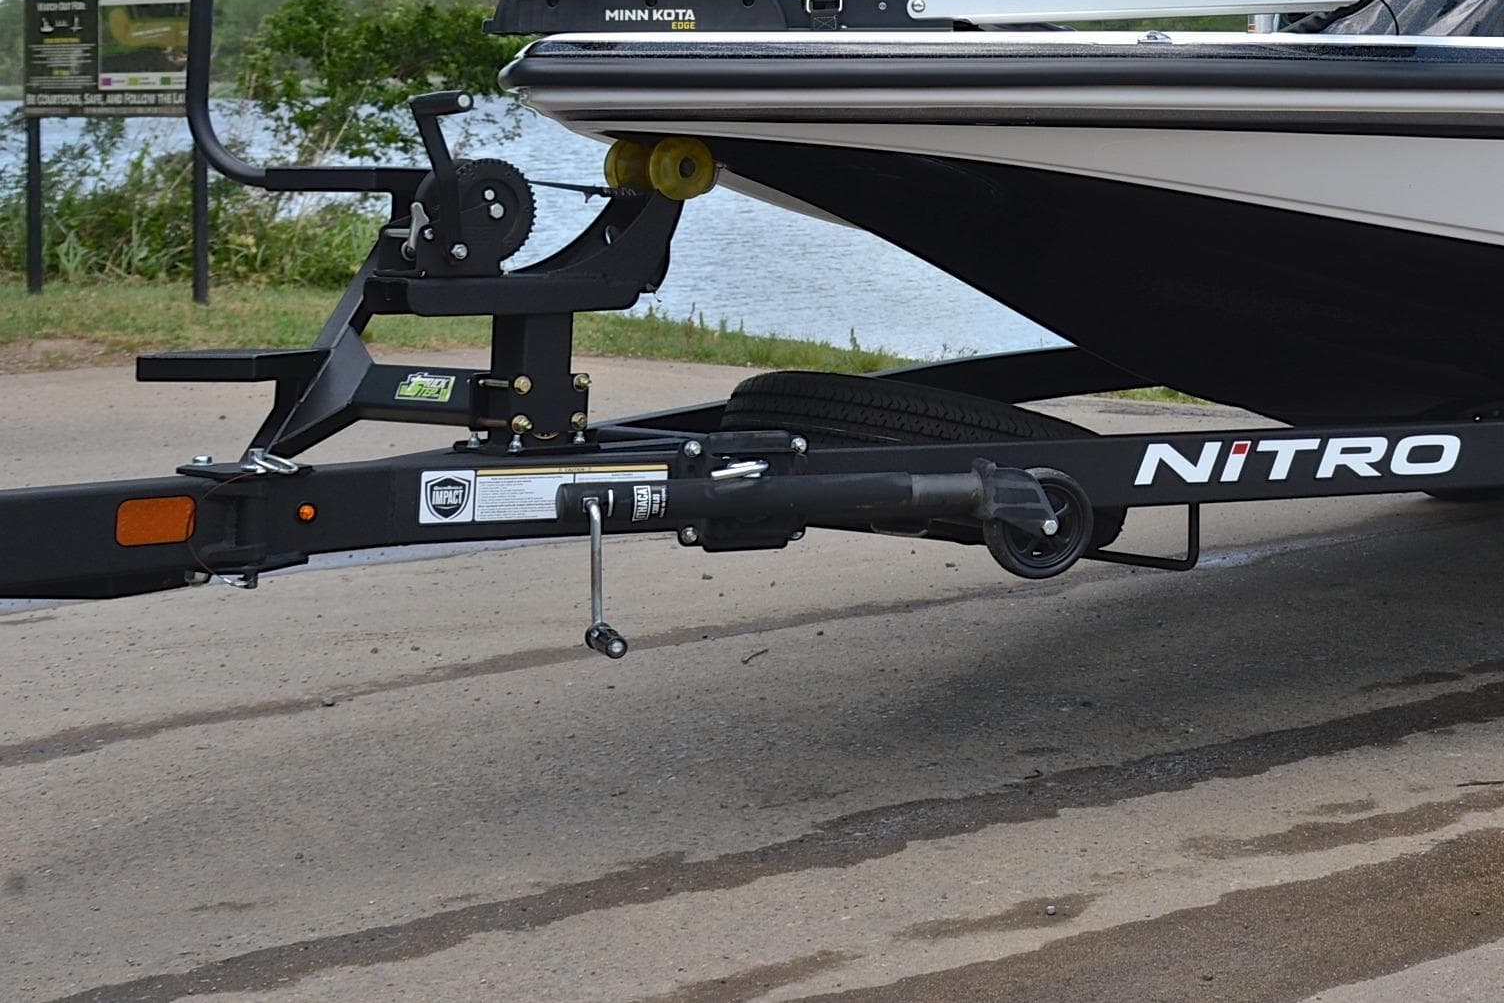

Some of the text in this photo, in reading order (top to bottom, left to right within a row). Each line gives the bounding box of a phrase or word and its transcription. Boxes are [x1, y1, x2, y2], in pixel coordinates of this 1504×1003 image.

[605, 9, 696, 22] MINN KOTA
[671, 21, 696, 30] EDGE
[124, 93, 156, 105] FOLLOW
[157, 93, 172, 104] THE
[1133, 434, 1462, 486] NITRO
[431, 489, 464, 505] IMPACT
[636, 488, 649, 519] ITHACA
